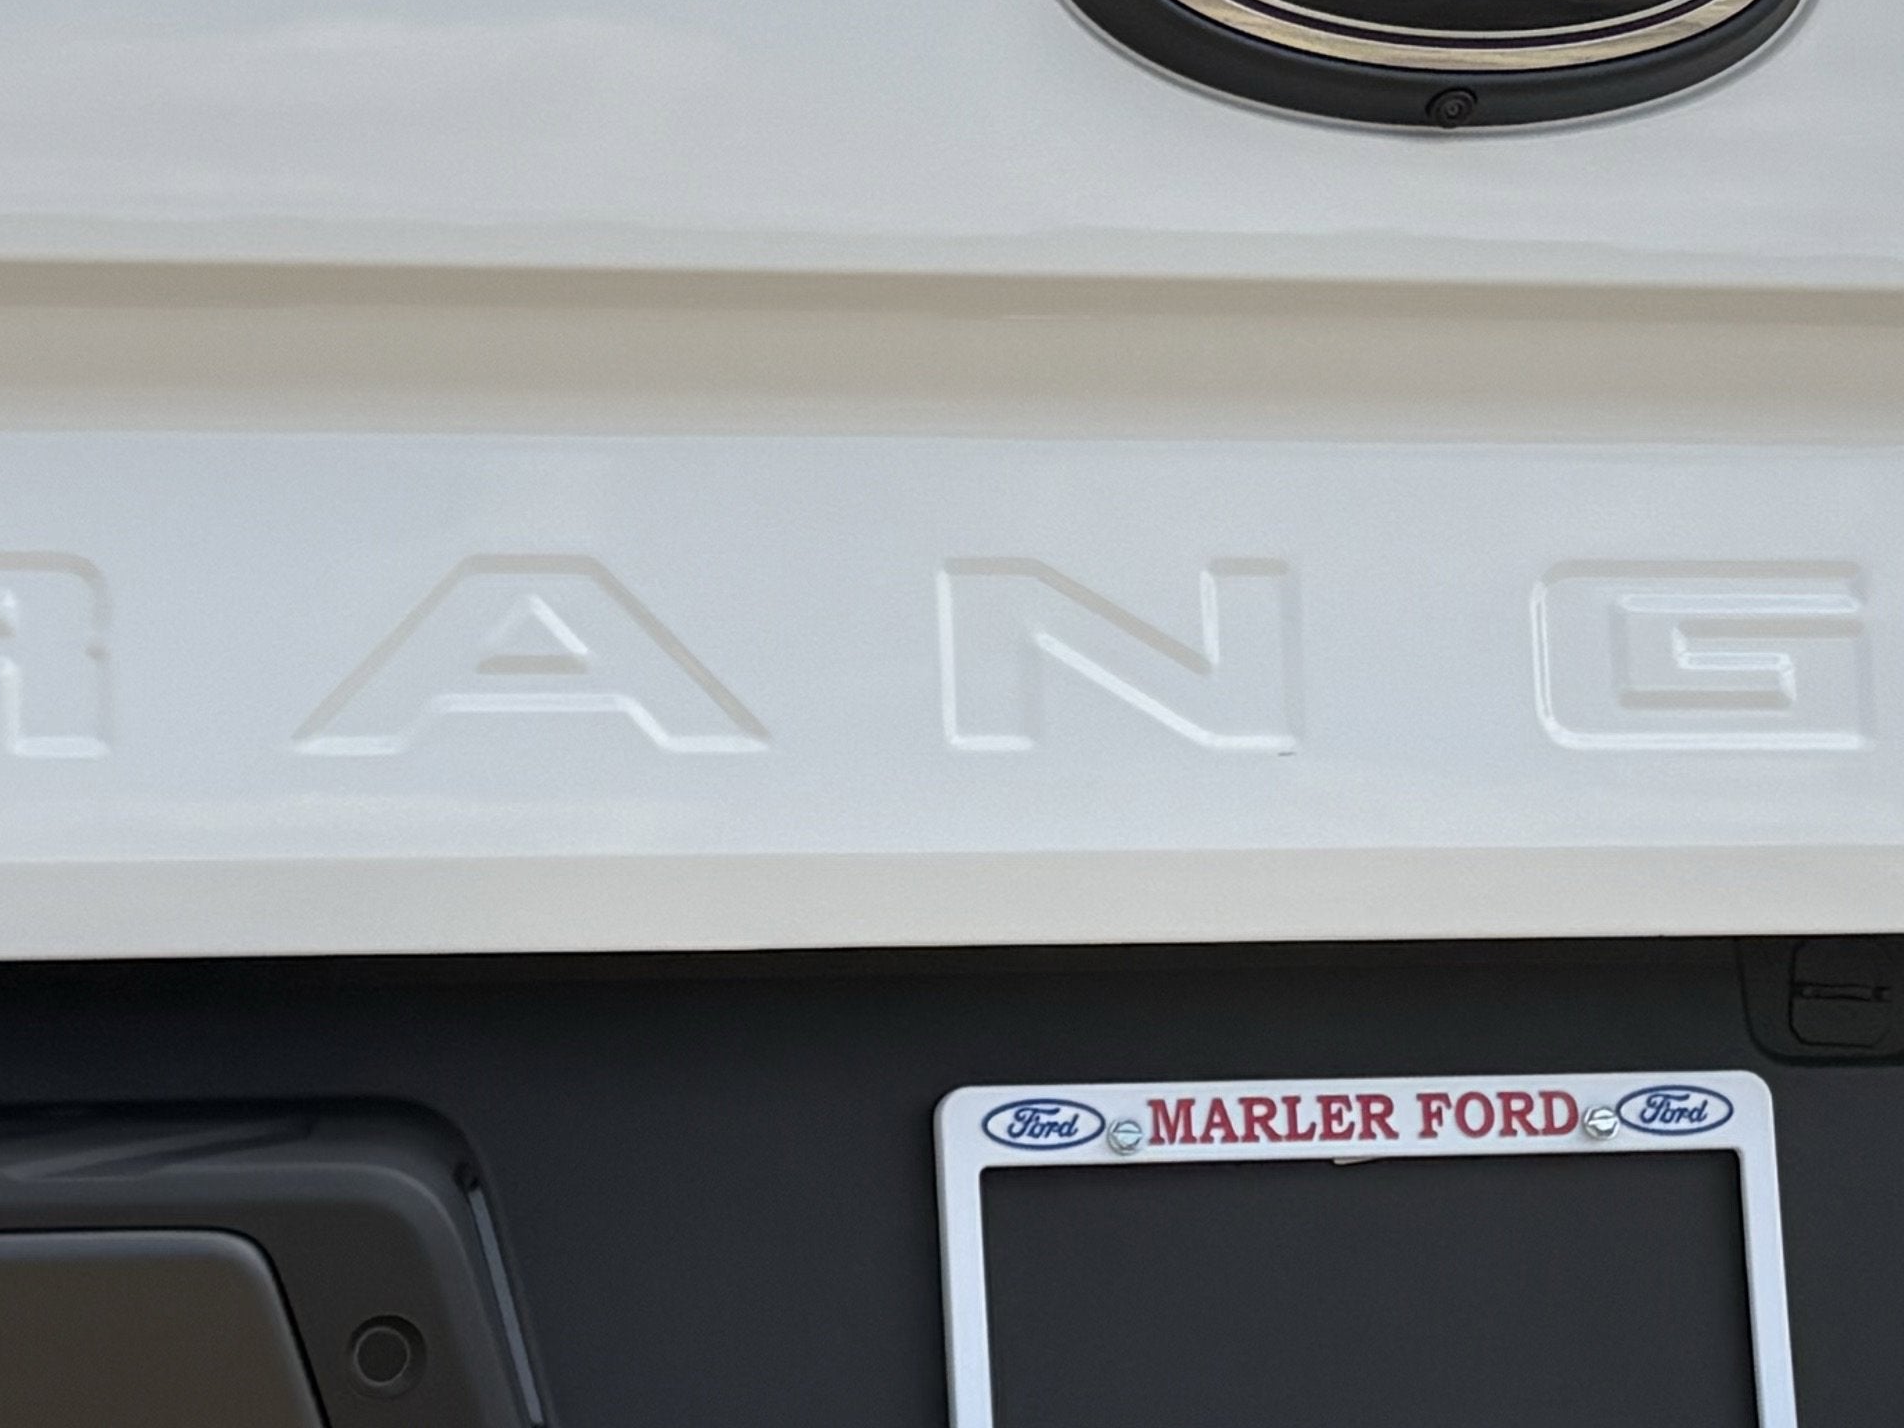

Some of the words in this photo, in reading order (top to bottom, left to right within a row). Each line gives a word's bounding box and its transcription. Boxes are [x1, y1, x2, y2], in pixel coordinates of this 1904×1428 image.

[1006, 1105, 1080, 1140] Ford
[1146, 1093, 1399, 1147] MARLER
[1415, 1089, 1581, 1140] FORD
[1638, 1092, 1709, 1124] Ford
